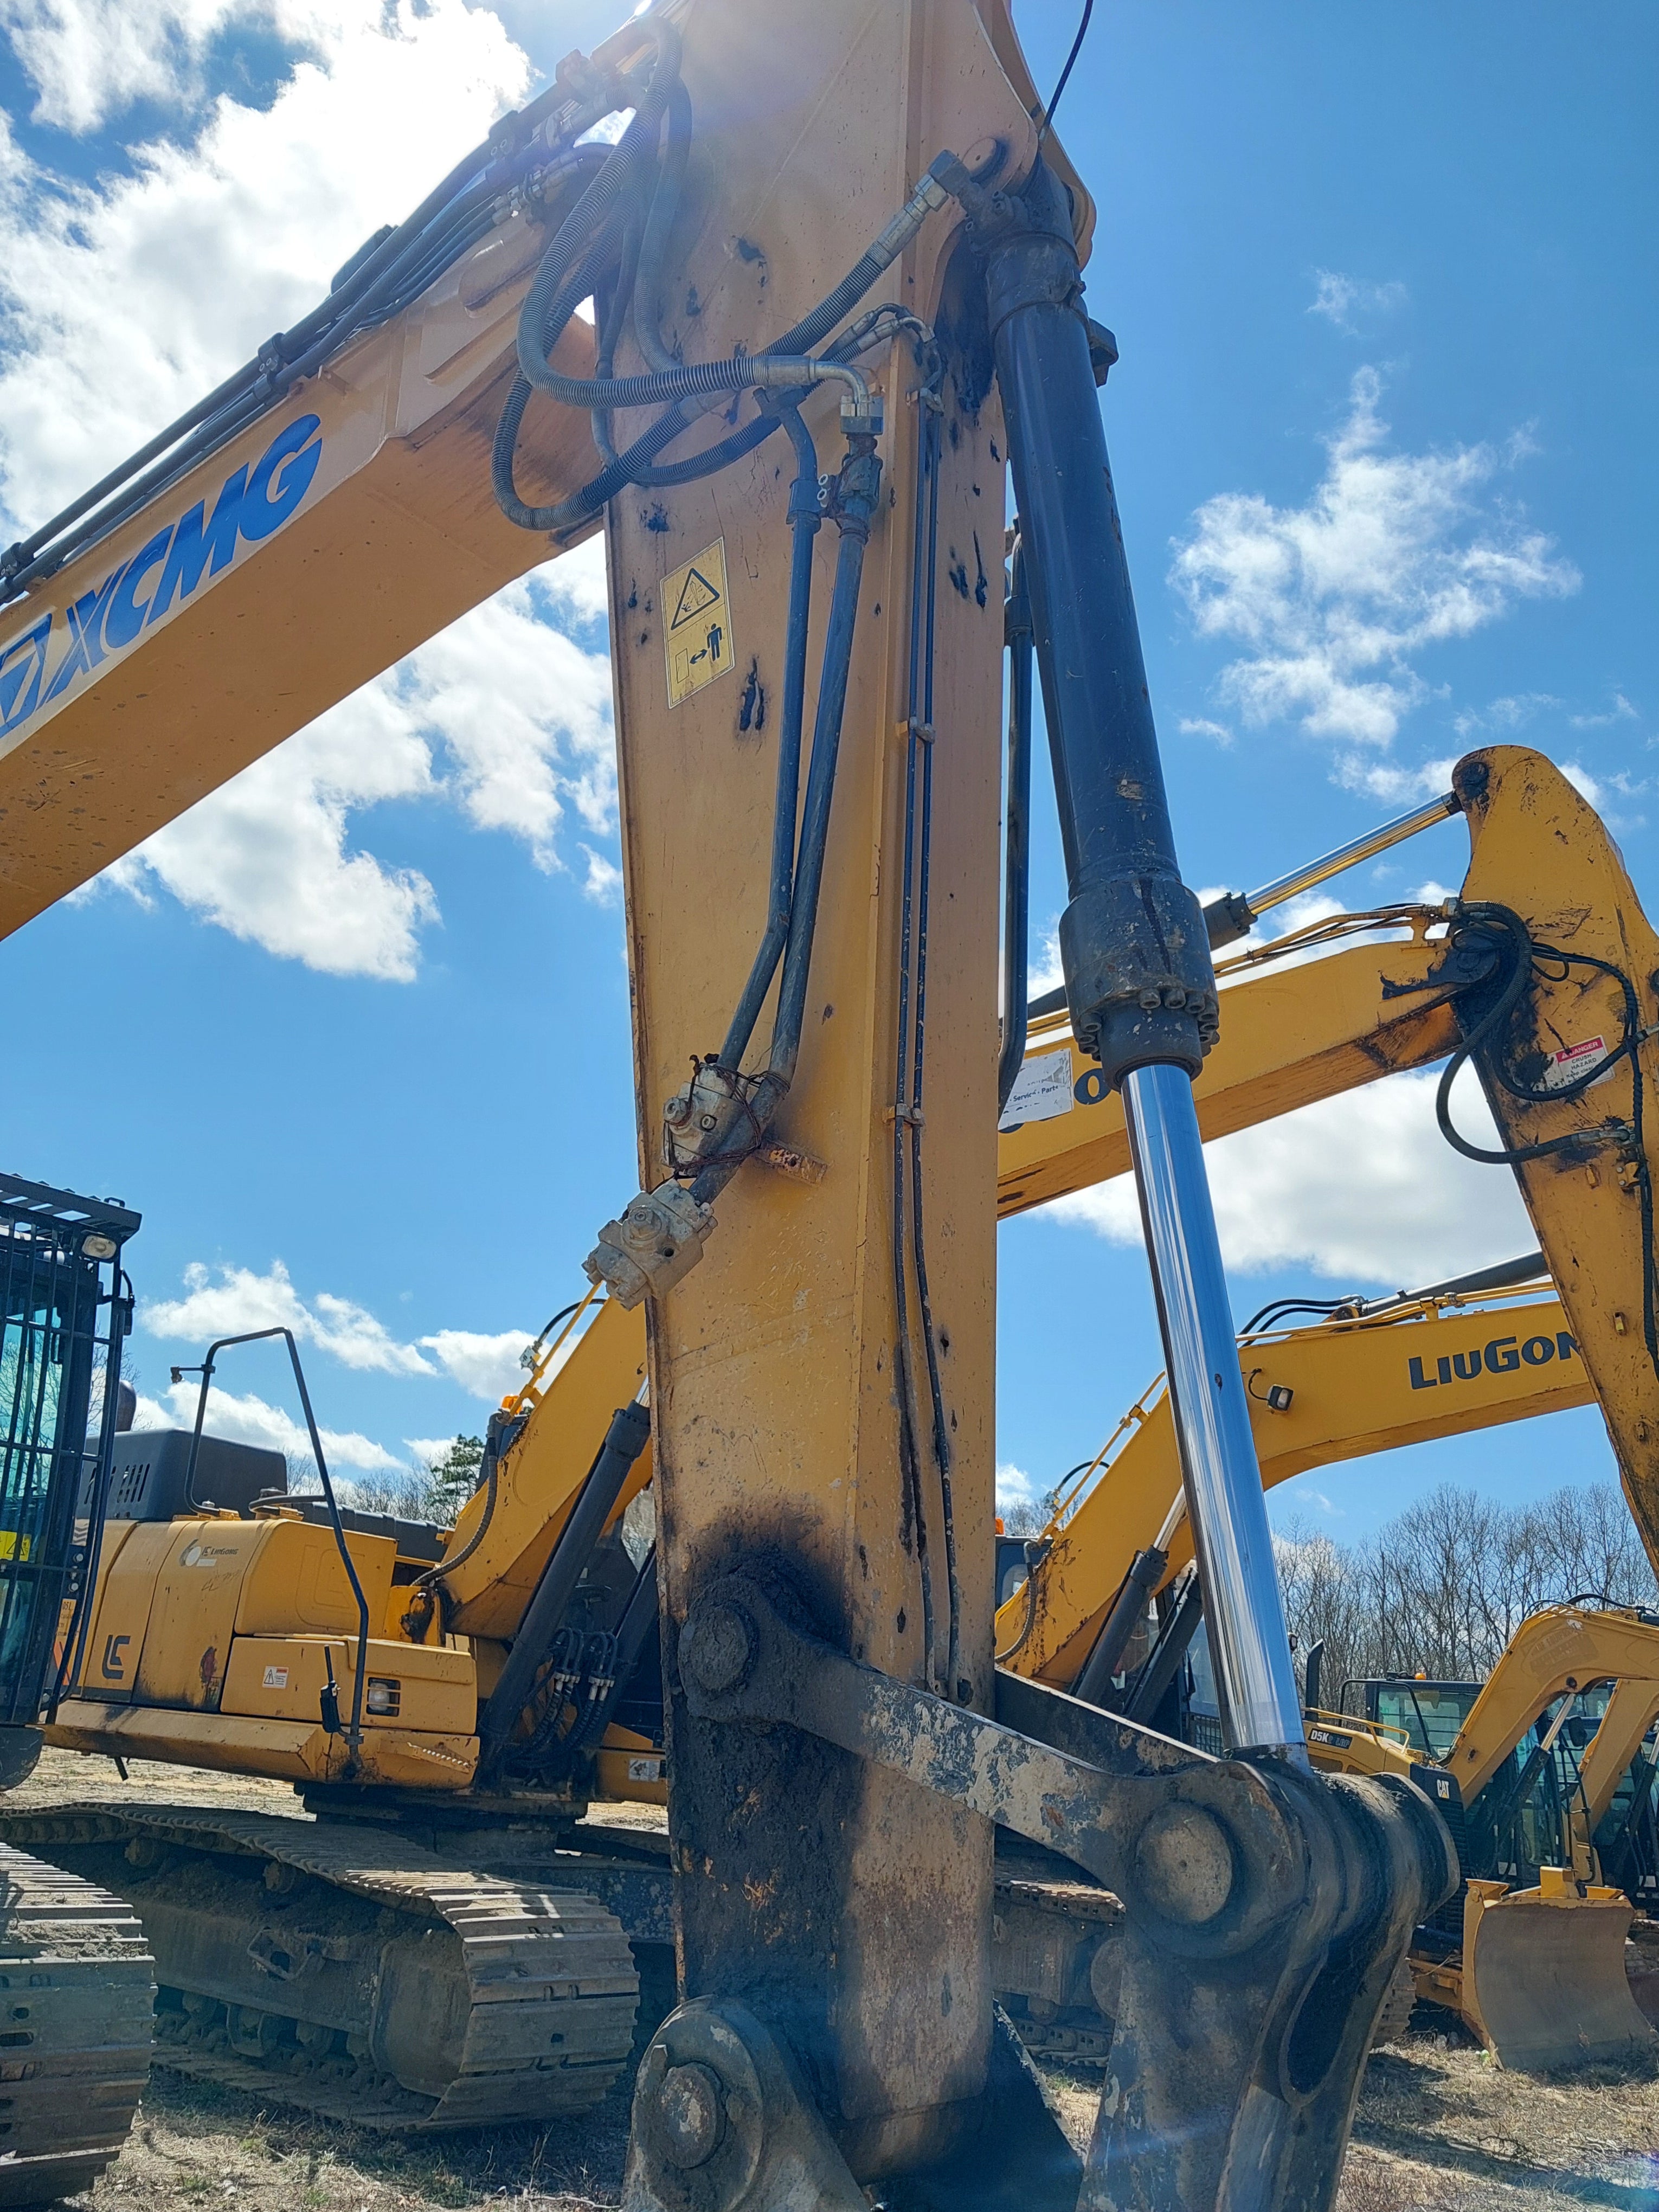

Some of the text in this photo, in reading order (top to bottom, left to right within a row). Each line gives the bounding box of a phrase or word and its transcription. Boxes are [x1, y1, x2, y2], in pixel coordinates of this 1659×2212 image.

[36, 414, 322, 712] XCMG
[1571, 1053, 1592, 1064] CRUSH
[1571, 1058, 1597, 1070] HAZARD
[1408, 1331, 1581, 1390] LIUGON
[1437, 1779, 1450, 1799] CAT
